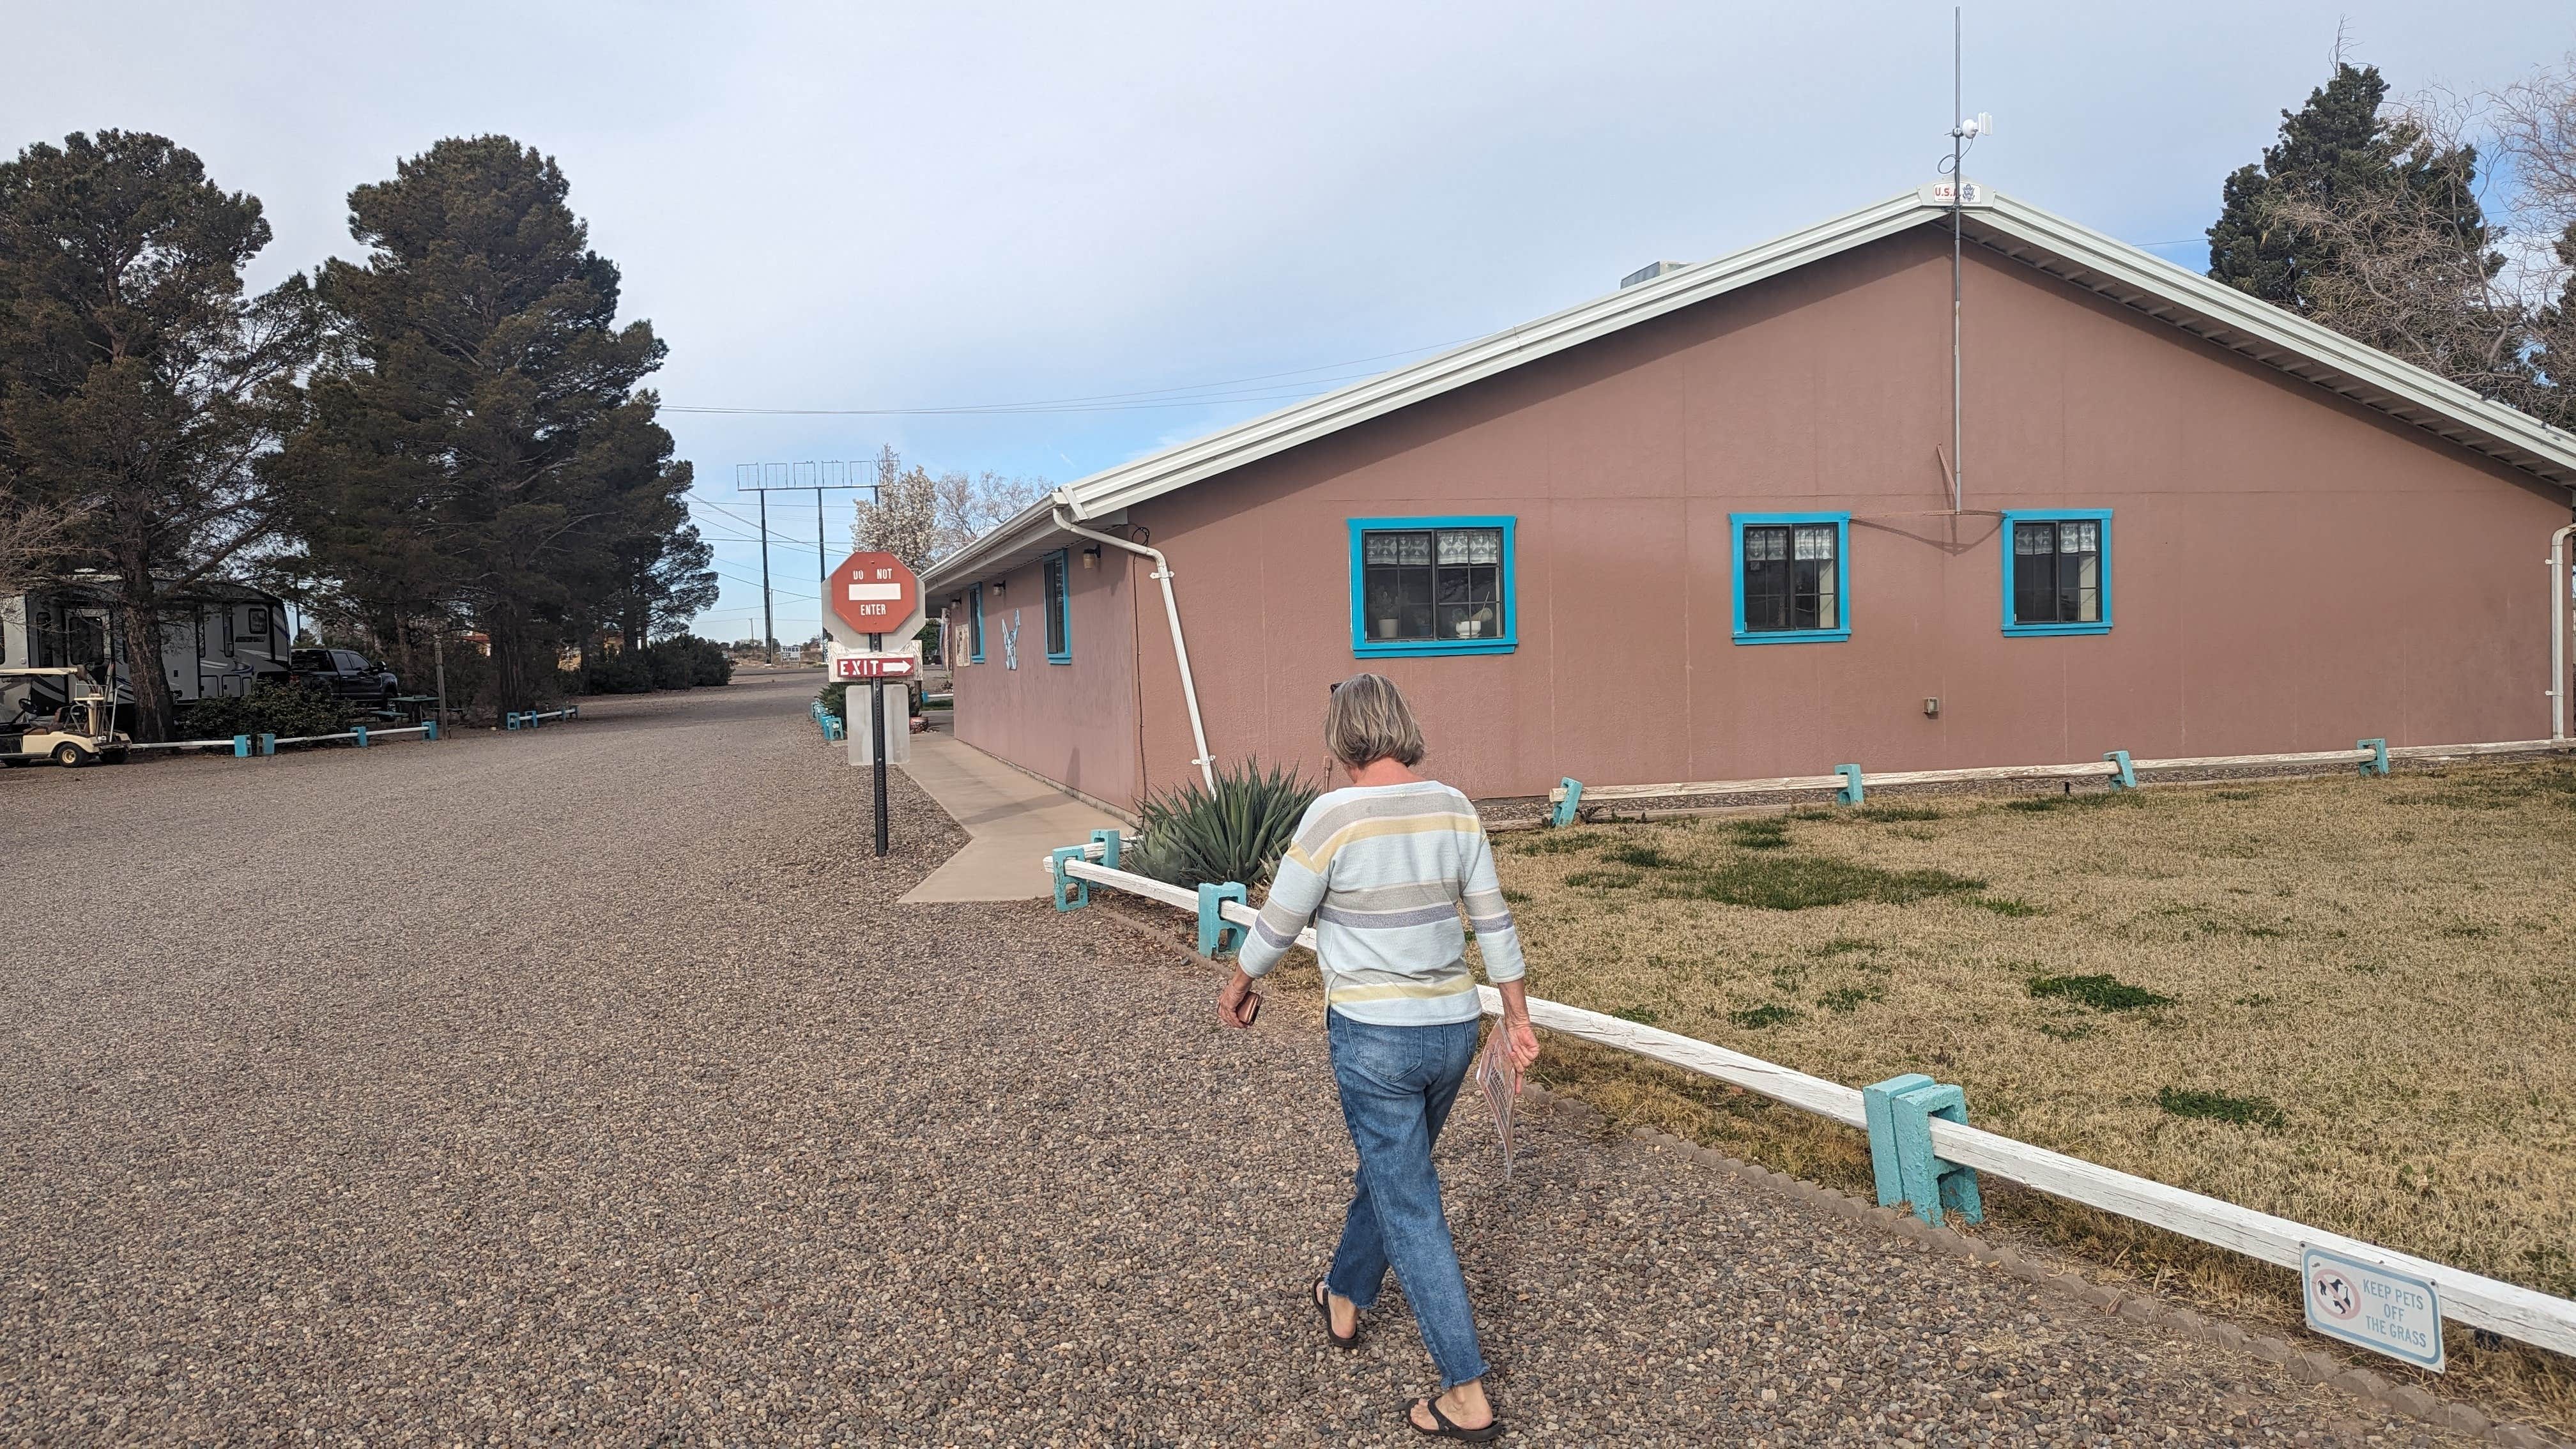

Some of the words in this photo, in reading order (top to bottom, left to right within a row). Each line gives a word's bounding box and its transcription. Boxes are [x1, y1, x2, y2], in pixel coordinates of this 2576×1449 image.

[853, 569, 864, 580] DO
[877, 568, 893, 579] NOT
[860, 604, 886, 616] ENTER
[840, 660, 879, 675] EXIT
[2363, 1278, 2391, 1300] KEEP
[2395, 1289, 2423, 1310] PETS
[2384, 1303, 2405, 1322] OFF
[2366, 1315, 2386, 1335] THE
[2389, 1323, 2426, 1347] GRASS
